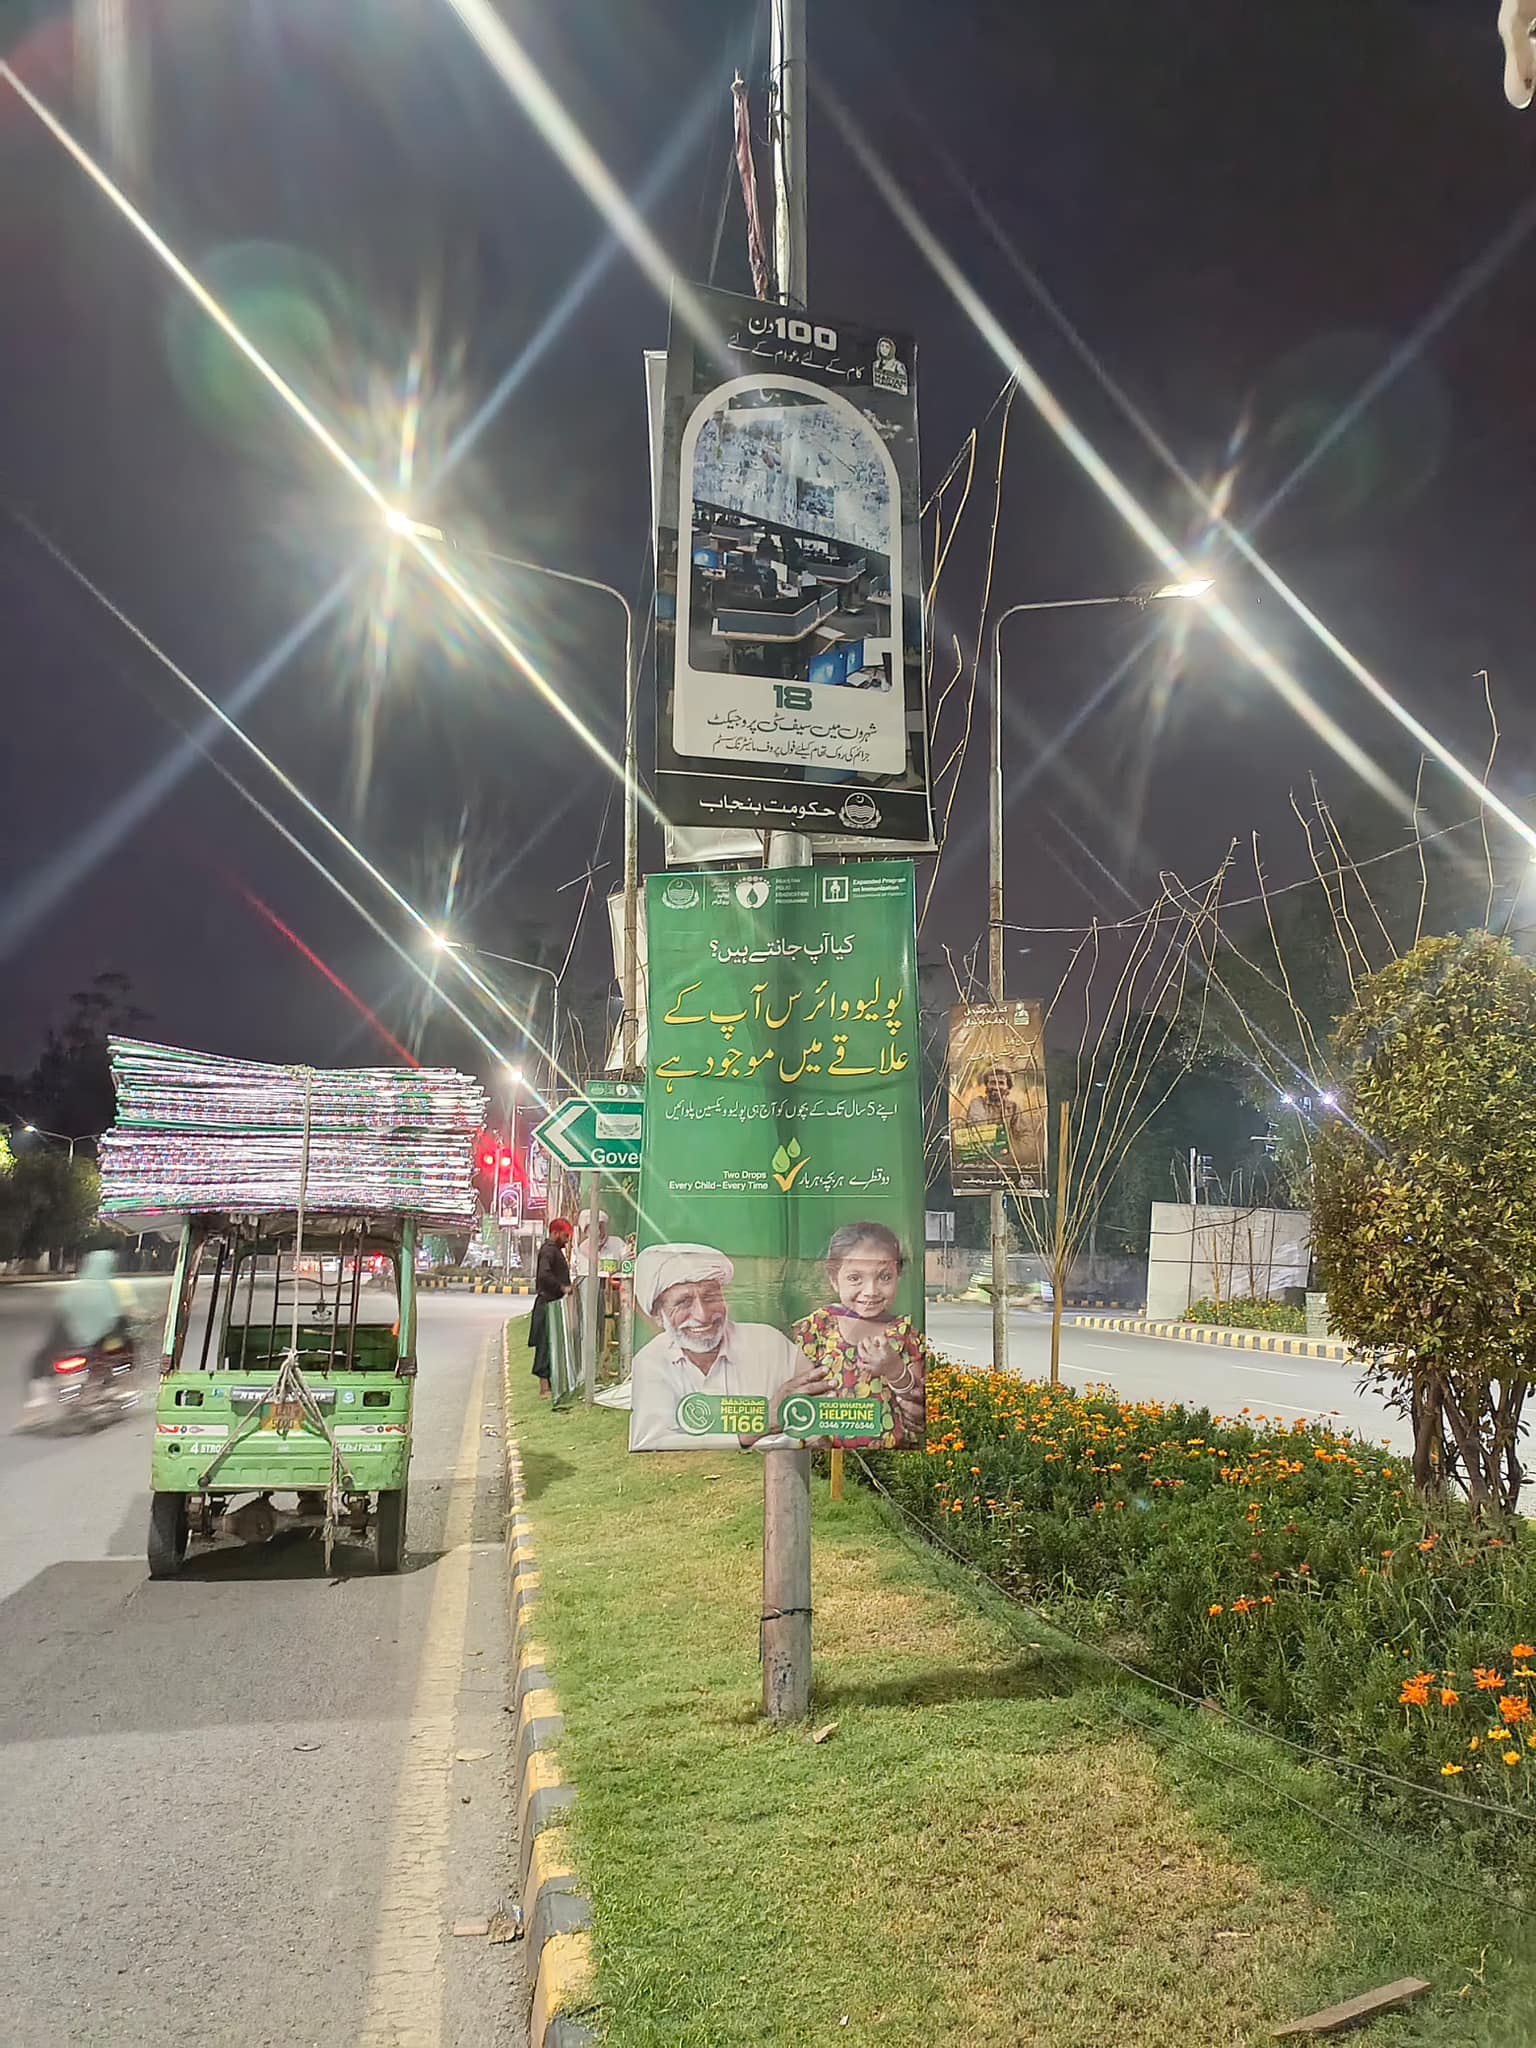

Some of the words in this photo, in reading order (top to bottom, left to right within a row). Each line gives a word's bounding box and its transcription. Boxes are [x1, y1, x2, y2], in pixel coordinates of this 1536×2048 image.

[748, 317, 774, 335] دن
[775, 317, 837, 351] 100
[773, 685, 812, 711] 18
[779, 718, 811, 735] سیف
[809, 724, 841, 739] میں
[838, 722, 878, 743] شہروں
[699, 794, 761, 816] پنجاب
[763, 800, 836, 819] حکومت
[750, 937, 802, 963] جانتے
[804, 932, 831, 965] آپ
[831, 934, 856, 960] کیا
[663, 981, 707, 1024] کے
[709, 980, 769, 1041] آپ
[765, 979, 850, 1029] وائرس
[851, 976, 904, 1035] پولیو
[700, 1048, 776, 1078] موجود
[778, 1037, 824, 1084] میں
[827, 1033, 909, 1076] علاقے
[655, 1055, 700, 1094] ہے
[728, 1100, 747, 1123] پولیو
[760, 1101, 777, 1119] آج
[775, 1099, 789, 1117] کو
[784, 1102, 809, 1121] بچوں
[809, 1100, 826, 1116] کے
[826, 1100, 847, 1116] تک
[844, 1099, 867, 1118] سال
[867, 1101, 876, 1116] 5
[876, 1103, 898, 1121] اپنے
[591, 1147, 641, 1165] Gove
[723, 1170, 740, 1179] Two
[741, 1170, 767, 1181] Drops
[849, 1168, 883, 1191] قطرے
[669, 1181, 693, 1191] Every
[747, 1180, 769, 1190] Time
[720, 1405, 766, 1415] HELPLINE
[820, 1409, 875, 1421] HELPLINE
[720, 1415, 765, 1433] 1166
[190, 1441, 199, 1454] 4
